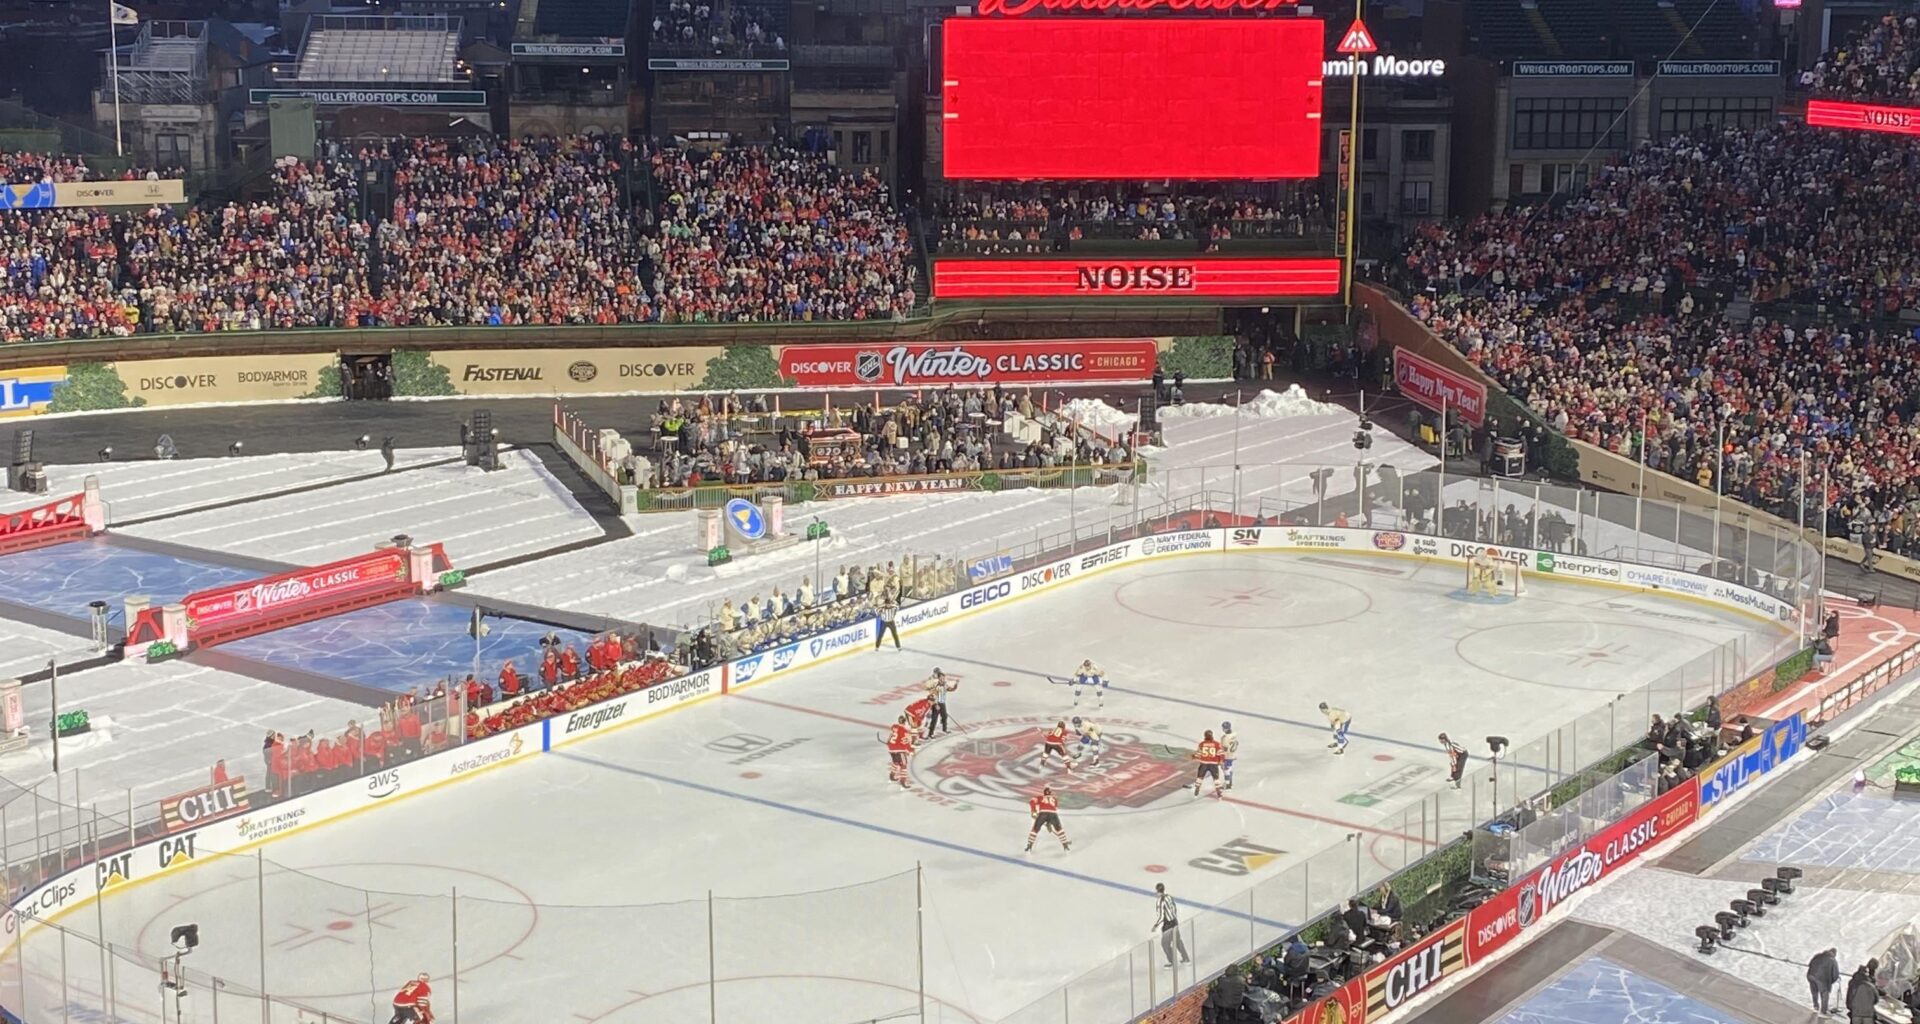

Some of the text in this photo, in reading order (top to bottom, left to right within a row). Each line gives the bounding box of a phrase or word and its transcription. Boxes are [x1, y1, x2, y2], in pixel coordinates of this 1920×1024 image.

[1374, 56, 1445, 76] Moore
[1519, 63, 1628, 74] WRIGLEYROOFTOPS.COM
[1662, 62, 1773, 73] WRIGLEYROOFTOPS.COM
[1863, 109, 1912, 127] NOISE
[76, 189, 115, 198] DISCOVER
[1077, 265, 1194, 290] NOISE
[237, 369, 308, 383] BODYARMOR
[463, 364, 543, 382] FASTENAL
[619, 362, 696, 377] DISCOVER
[790, 360, 852, 375] DISCOVER
[885, 346, 992, 386] Winter
[995, 352, 1083, 373] CLASSIC
[1096, 357, 1139, 368] CHICAGO
[140, 374, 216, 391] DISCOVER
[1408, 365, 1480, 416] Happy New Year!
[835, 478, 963, 496] HAPPY NEW YEAR!
[1156, 532, 1211, 544] NAVY FEDERAL
[1232, 529, 1262, 541] SN
[1156, 540, 1211, 553] CREDIT UNION
[977, 556, 1012, 579] STL
[1021, 563, 1071, 591] DISCOVER
[1540, 557, 1619, 577] enterprise
[312, 569, 359, 589] CLASSIC
[1672, 577, 1709, 592] MIDWAY
[252, 578, 311, 610] Winter
[960, 581, 1011, 610] GEICO
[1725, 587, 1776, 615] MassMutual
[900, 604, 950, 628] MassMutual
[825, 628, 869, 651] FANDUEL
[774, 650, 795, 668] SAP
[736, 664, 759, 680] SAP
[648, 673, 710, 703] BODYARMOR
[565, 702, 627, 734] Energizer
[451, 749, 511, 775] AstraZeneca
[1202, 747, 1216, 757] 59
[368, 769, 400, 790] aws
[1710, 753, 1749, 801] STL
[179, 786, 237, 822] CHI
[249, 820, 300, 841] SPORTSBOOK
[159, 833, 196, 868] CAT
[1188, 838, 1288, 876] CAT
[97, 853, 132, 889] CAT
[1478, 907, 1517, 947] DISCOVER
[1538, 846, 1603, 916] Winter
[1605, 816, 1659, 866] CLASSIC
[40, 882, 76, 909] Clips
[1385, 940, 1443, 1008] CHI
